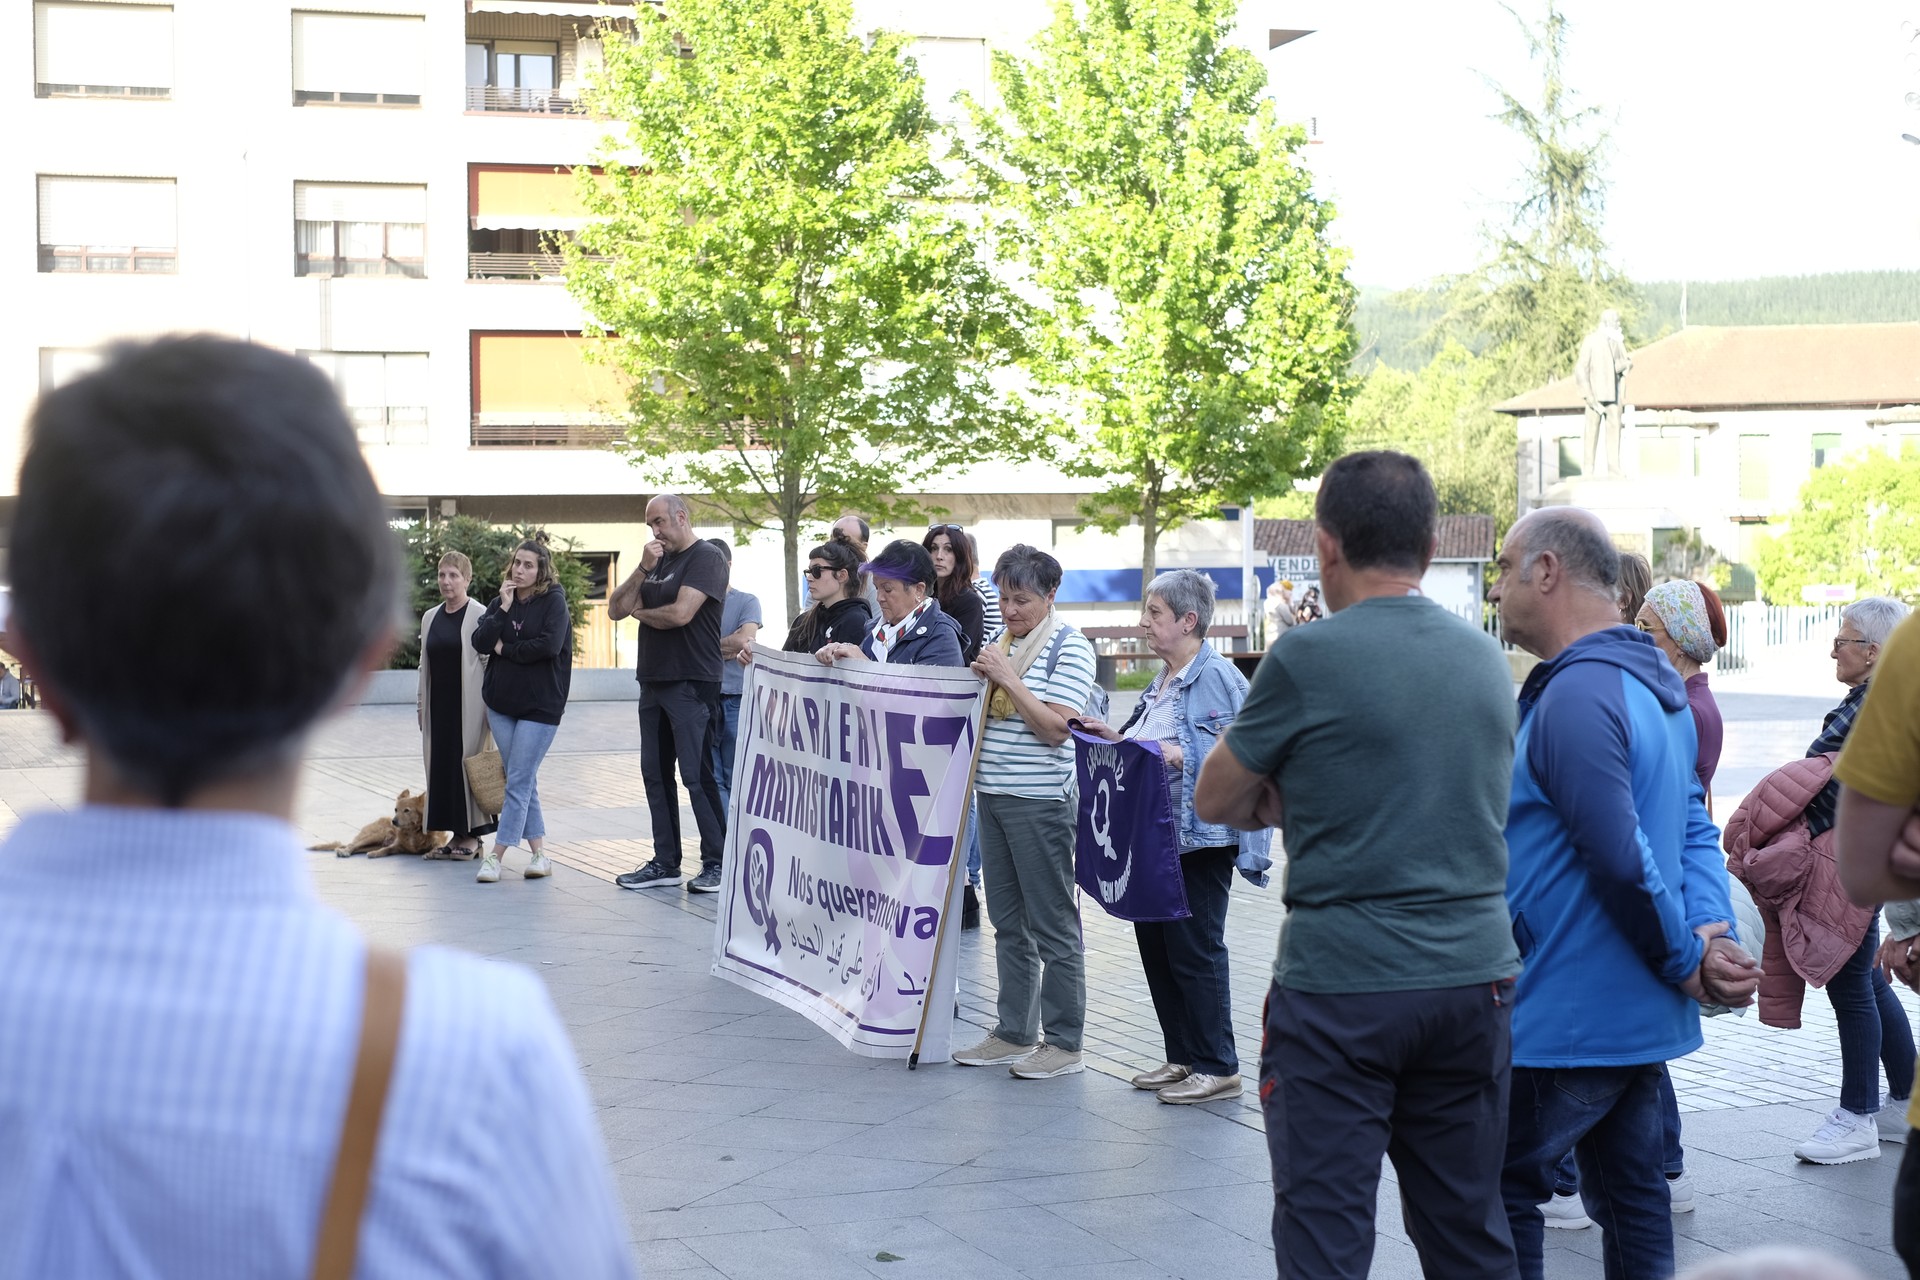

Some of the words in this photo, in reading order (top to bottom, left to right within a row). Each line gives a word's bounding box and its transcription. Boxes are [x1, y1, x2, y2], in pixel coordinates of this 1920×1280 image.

[746, 753, 895, 857] MATXISTARIK
[788, 856, 813, 905] Nos
[787, 918, 823, 960] الحياة
[826, 932, 845, 974] قيد
[841, 938, 862, 984] على
